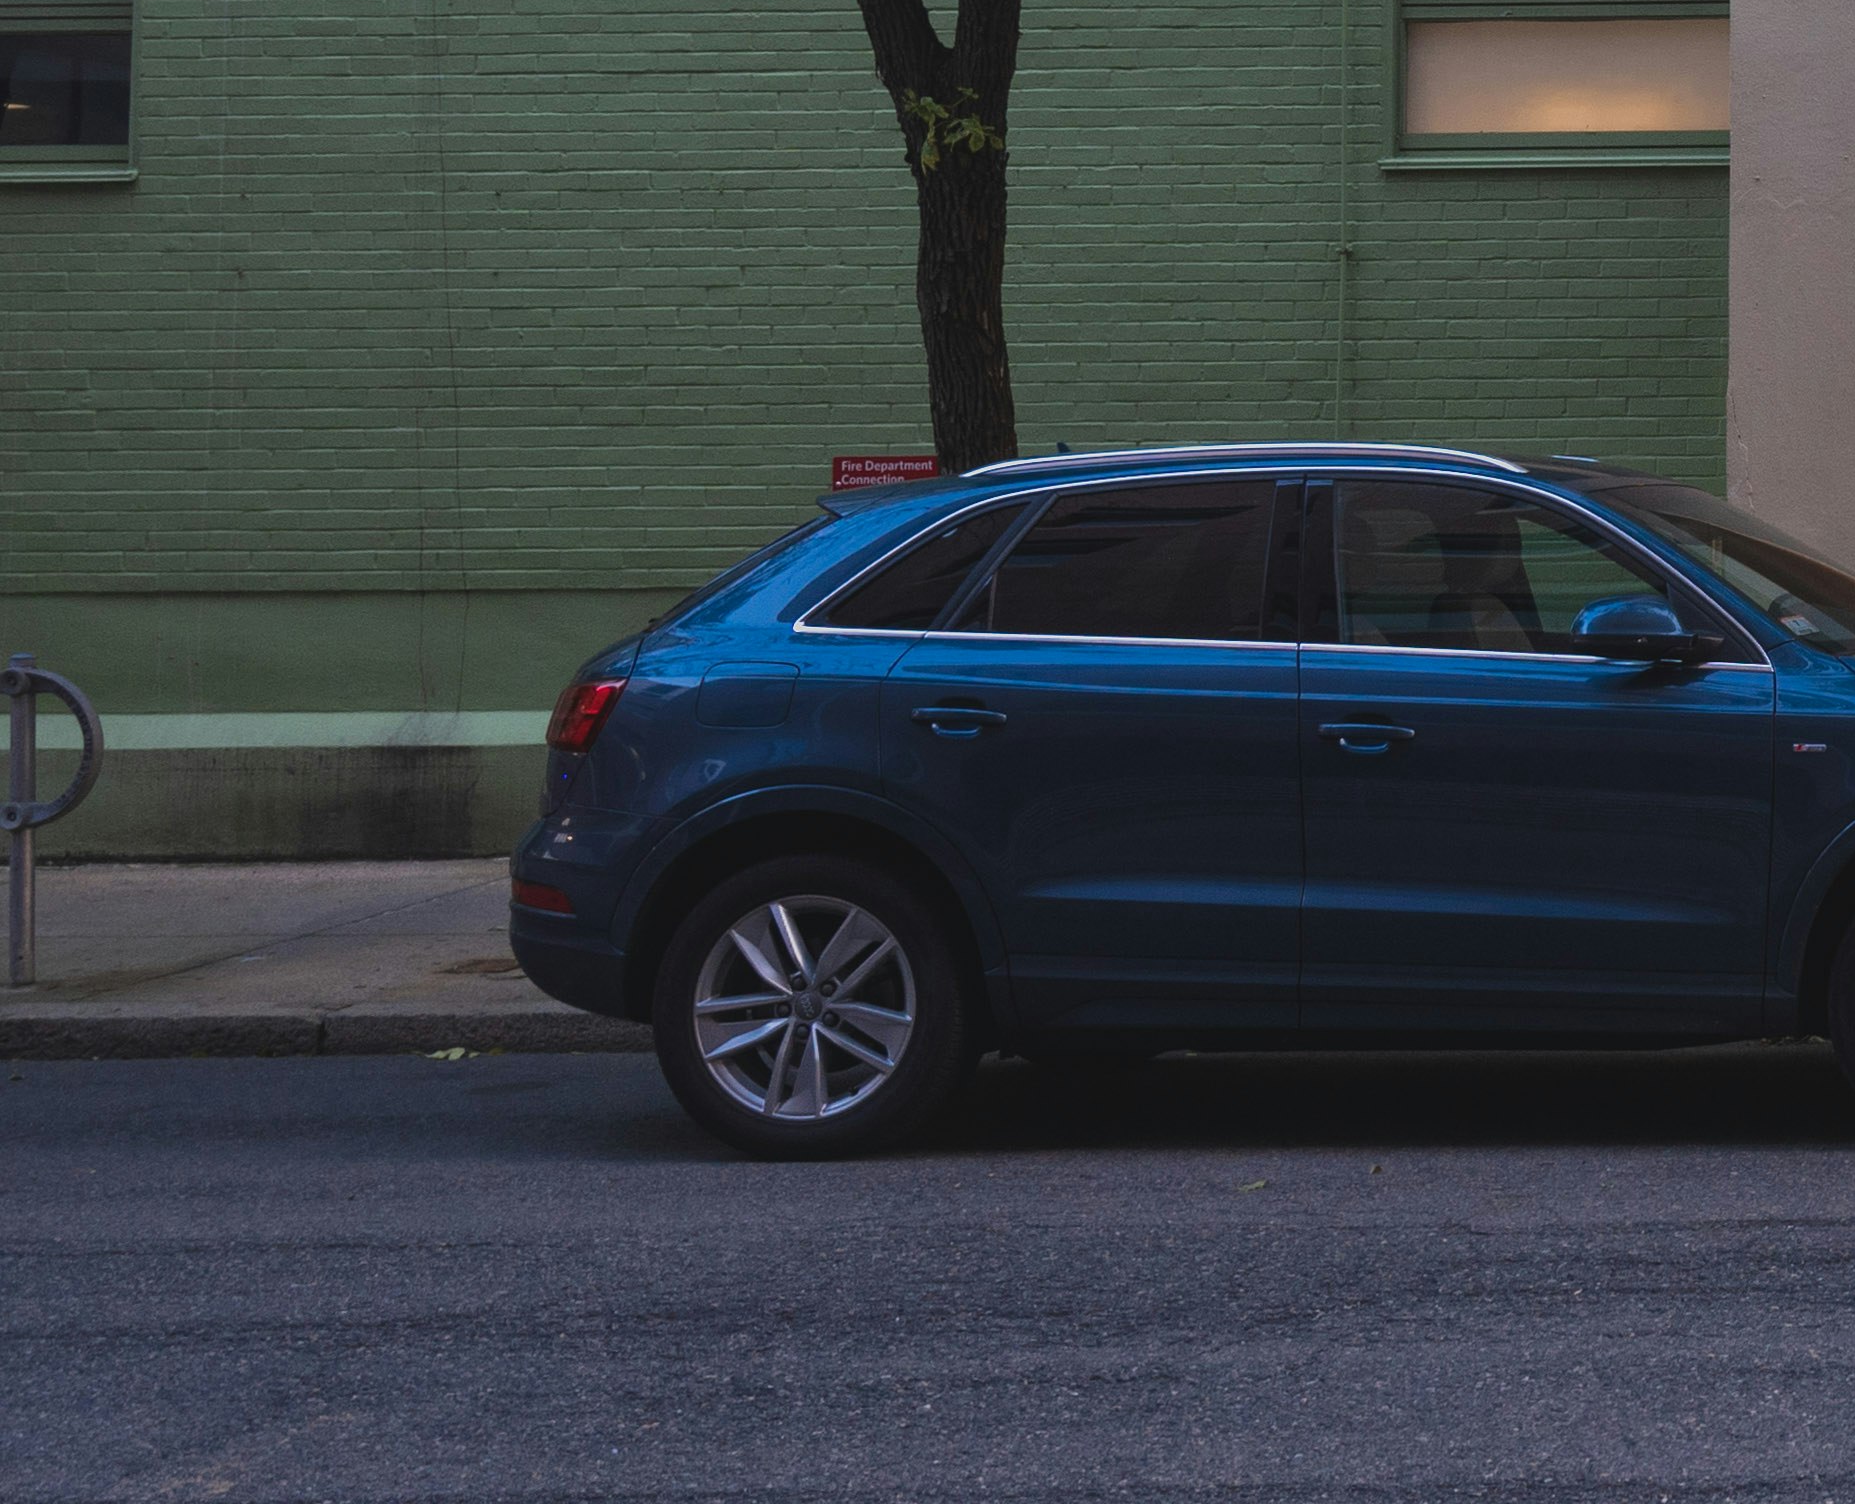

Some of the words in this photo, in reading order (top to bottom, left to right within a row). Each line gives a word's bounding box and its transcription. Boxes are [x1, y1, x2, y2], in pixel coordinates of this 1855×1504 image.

[841, 460, 863, 472] Fire
[865, 460, 933, 473] Department
[841, 474, 905, 485] Connection
